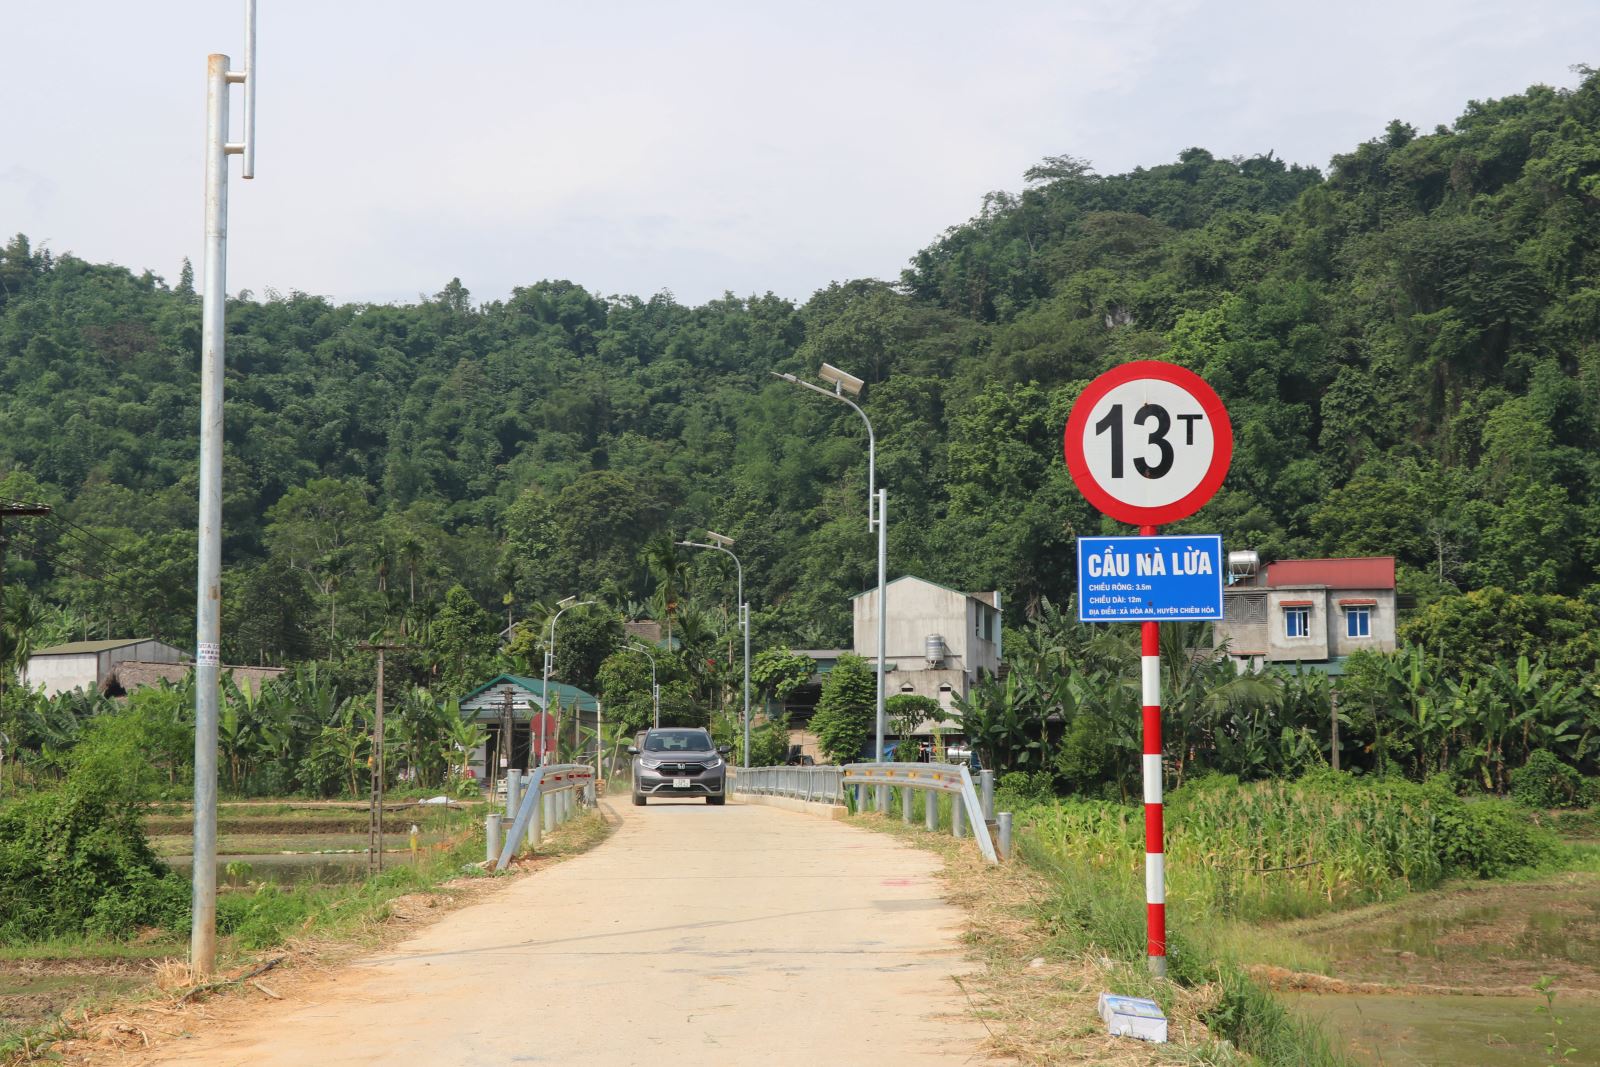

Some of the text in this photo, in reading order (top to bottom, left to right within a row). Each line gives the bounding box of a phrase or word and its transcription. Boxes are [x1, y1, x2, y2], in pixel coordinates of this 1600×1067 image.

[1088, 545, 1213, 577] CẦU NÀ LỪA
